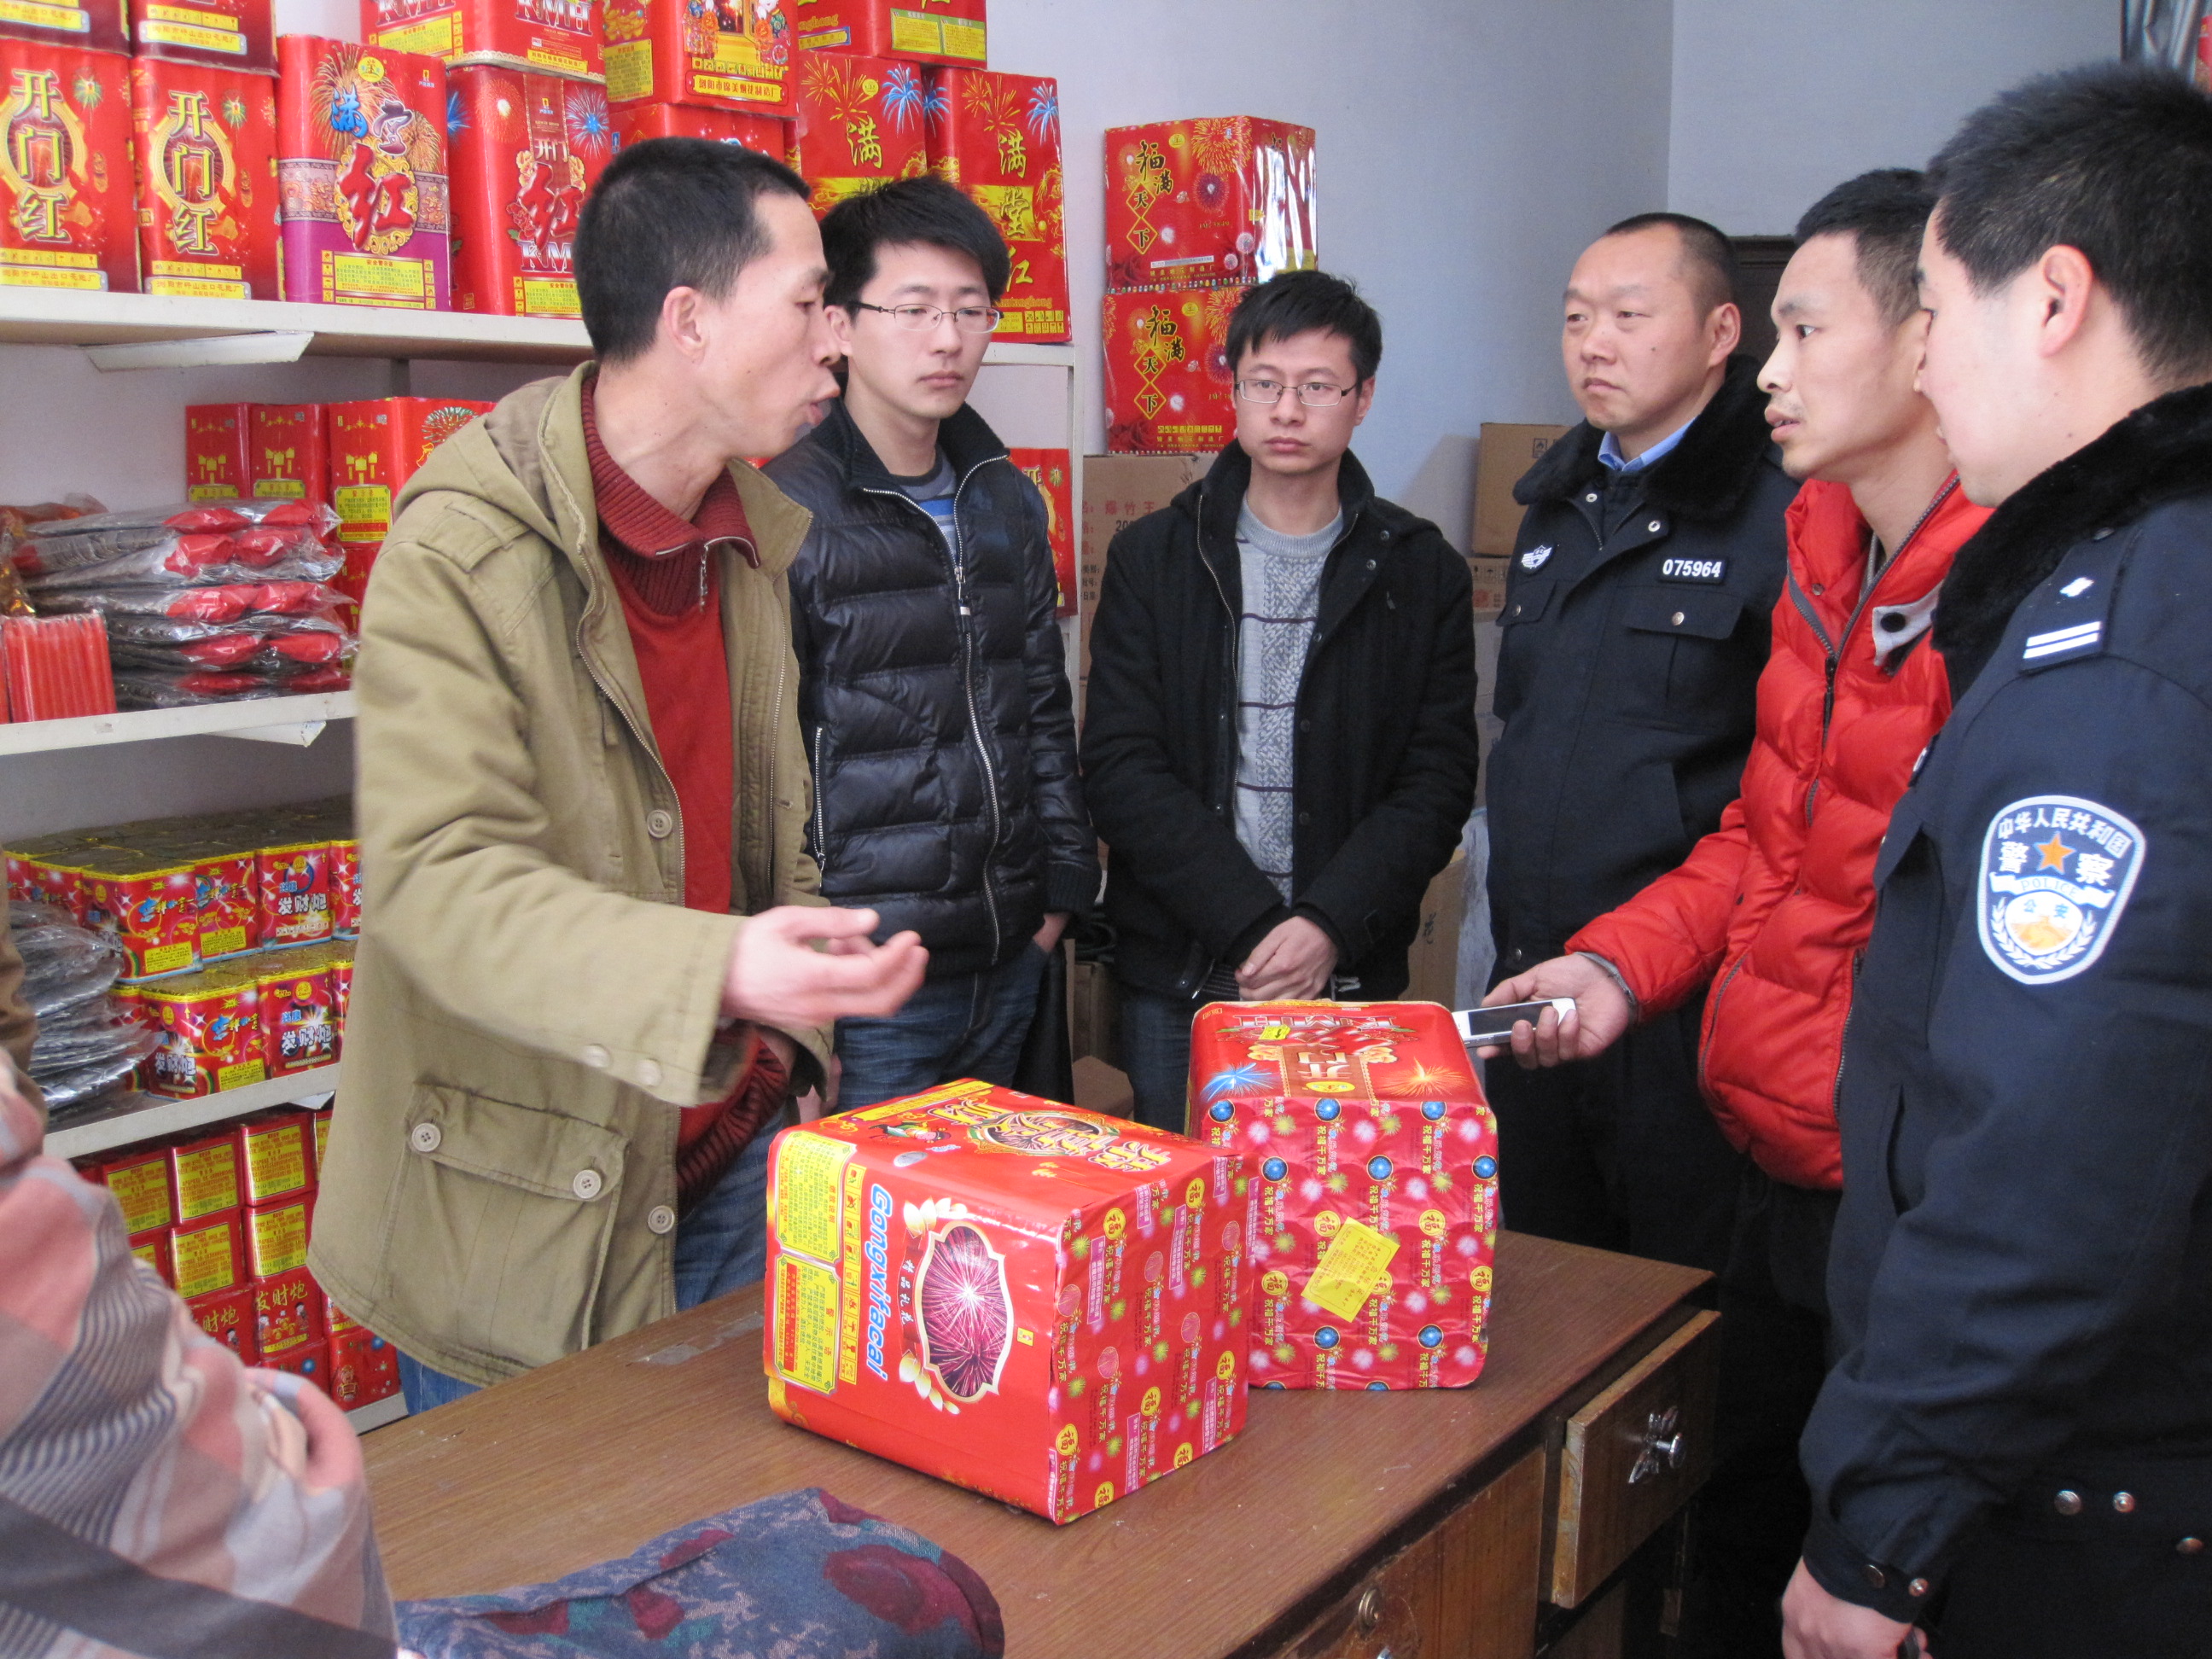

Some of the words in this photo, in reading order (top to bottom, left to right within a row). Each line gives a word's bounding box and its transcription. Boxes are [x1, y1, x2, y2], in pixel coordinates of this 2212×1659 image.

[12, 69, 72, 242] 开门红
[168, 90, 219, 255] 开门红
[535, 137, 569, 162] 开门
[1133, 140, 1174, 249] 福满天下
[518, 240, 573, 272] KM
[1142, 306, 1185, 413] 福满天下
[1662, 559, 1722, 578] 075964
[1998, 807, 2133, 859] 中华人民共和国
[1999, 841, 2029, 874] 警
[2075, 853, 2114, 887] 察
[2021, 877, 2078, 897] POLICE
[277, 893, 327, 916] 发财炮
[2023, 899, 2037, 913] 公
[2053, 904, 2069, 919] 安
[281, 1025, 332, 1056] 发财炮
[1317, 1126, 1326, 1175] 祝福千万家
[1423, 1125, 1432, 1174] 祝福千万家
[1189, 1185, 1201, 1202] 福
[1264, 1186, 1273, 1235] 祝福千万家
[1474, 1184, 1483, 1232] 祝福千万家
[1107, 1214, 1121, 1235] 福
[1185, 1213, 1194, 1272] 祝福千万家
[1318, 1215, 1335, 1233] 福
[1423, 1214, 1441, 1231] 福
[864, 1182, 894, 1382] Gongxifacai
[1103, 1245, 1114, 1305] 祝福千万家
[1222, 1255, 1231, 1313] 祝福千万家
[1266, 1275, 1283, 1291] 福
[1421, 1239, 1431, 1288] 祝福千万家
[1476, 1270, 1492, 1287] 福
[256, 1280, 308, 1311] 发财炮
[900, 1258, 916, 1325] 精品礼花
[195, 1306, 240, 1333] 财炮
[824, 1307, 835, 1357] 警示语
[1144, 1287, 1153, 1346] 祝福千万家
[1265, 1299, 1274, 1346] 祝福千万家
[1369, 1298, 1378, 1346] 祝福千万家
[1220, 1356, 1231, 1375] 福
[1099, 1383, 1109, 1442] 祝福千万家
[1144, 1392, 1157, 1412] 福
[1061, 1431, 1075, 1451] 福
[1139, 1420, 1149, 1479] 祝福千万家
[1177, 1448, 1189, 1468] 福
[1057, 1460, 1068, 1520] 祝福千万家
[1097, 1487, 1110, 1508] 福
